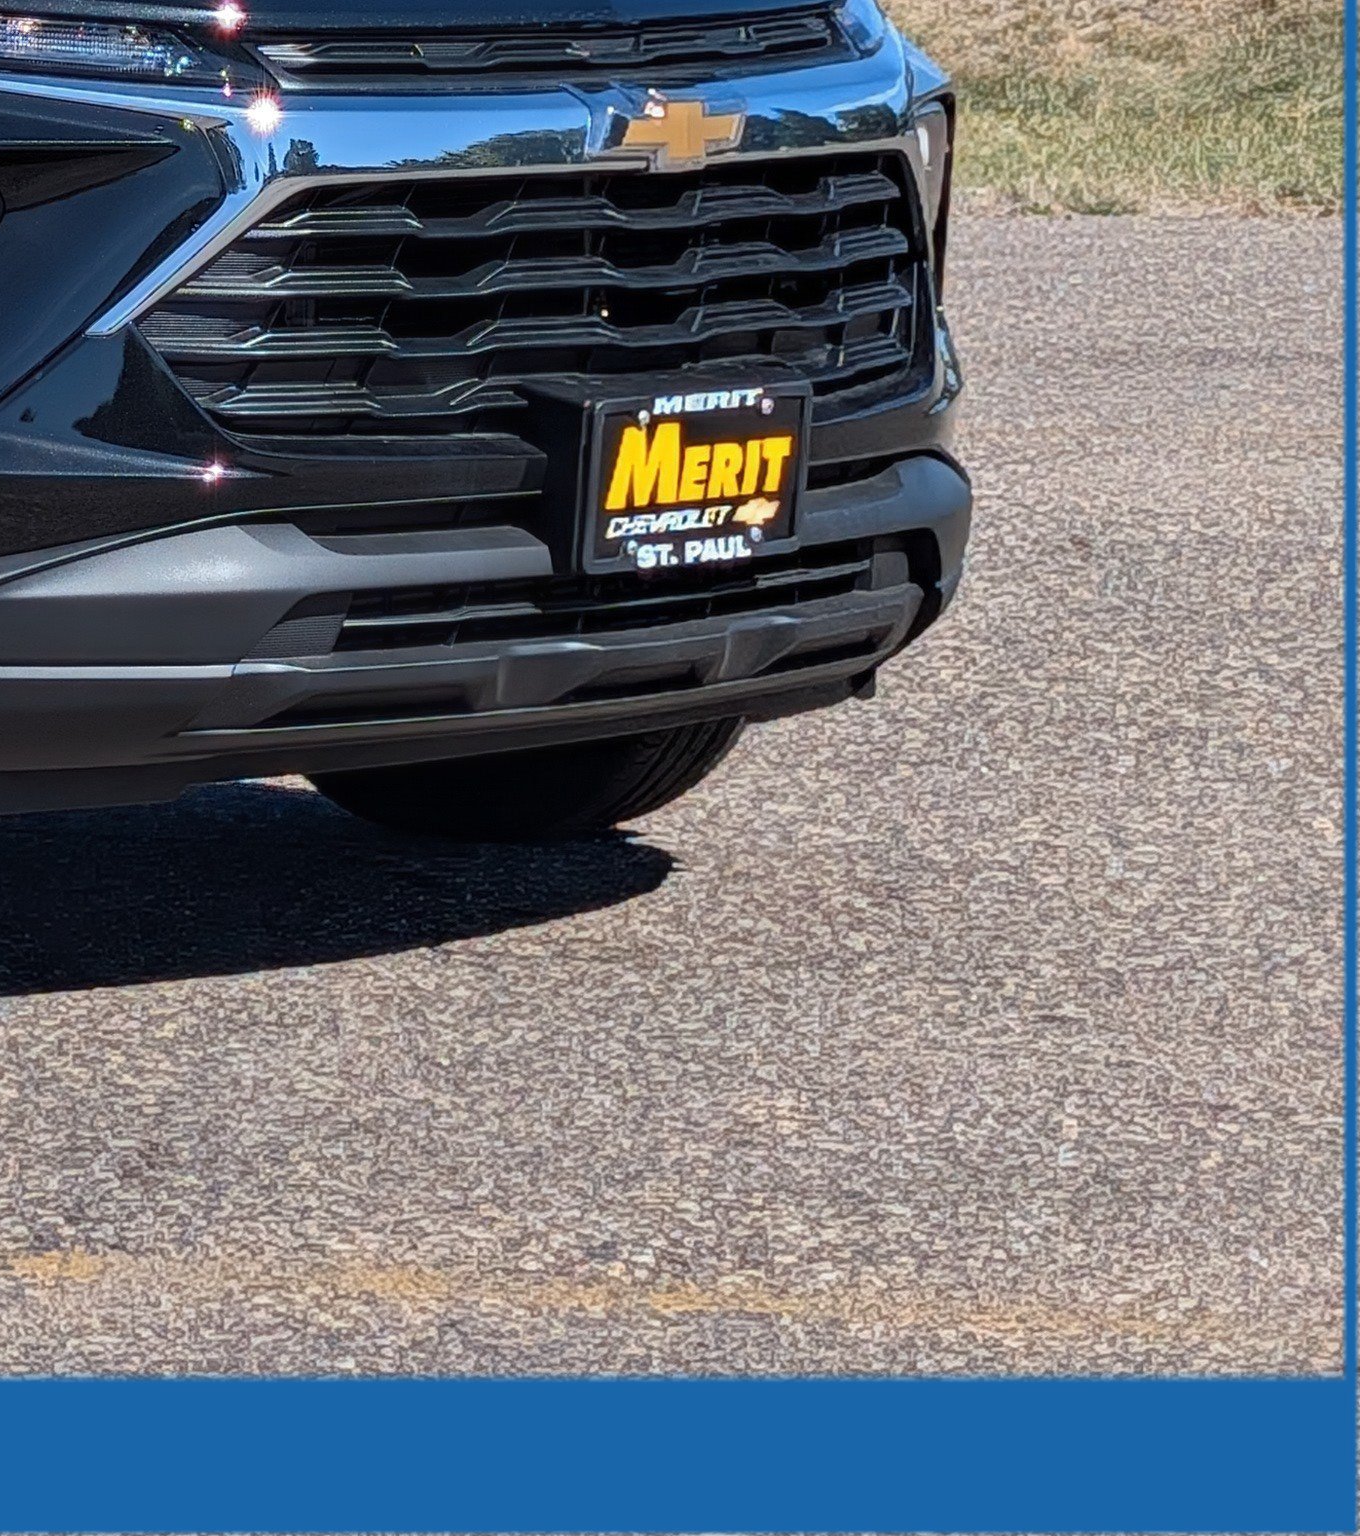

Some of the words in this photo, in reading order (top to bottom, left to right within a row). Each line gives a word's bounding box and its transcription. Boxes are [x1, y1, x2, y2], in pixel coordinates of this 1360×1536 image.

[605, 422, 792, 509] MERIT
[636, 543, 679, 569] ST.
[684, 535, 752, 565] PAUL
